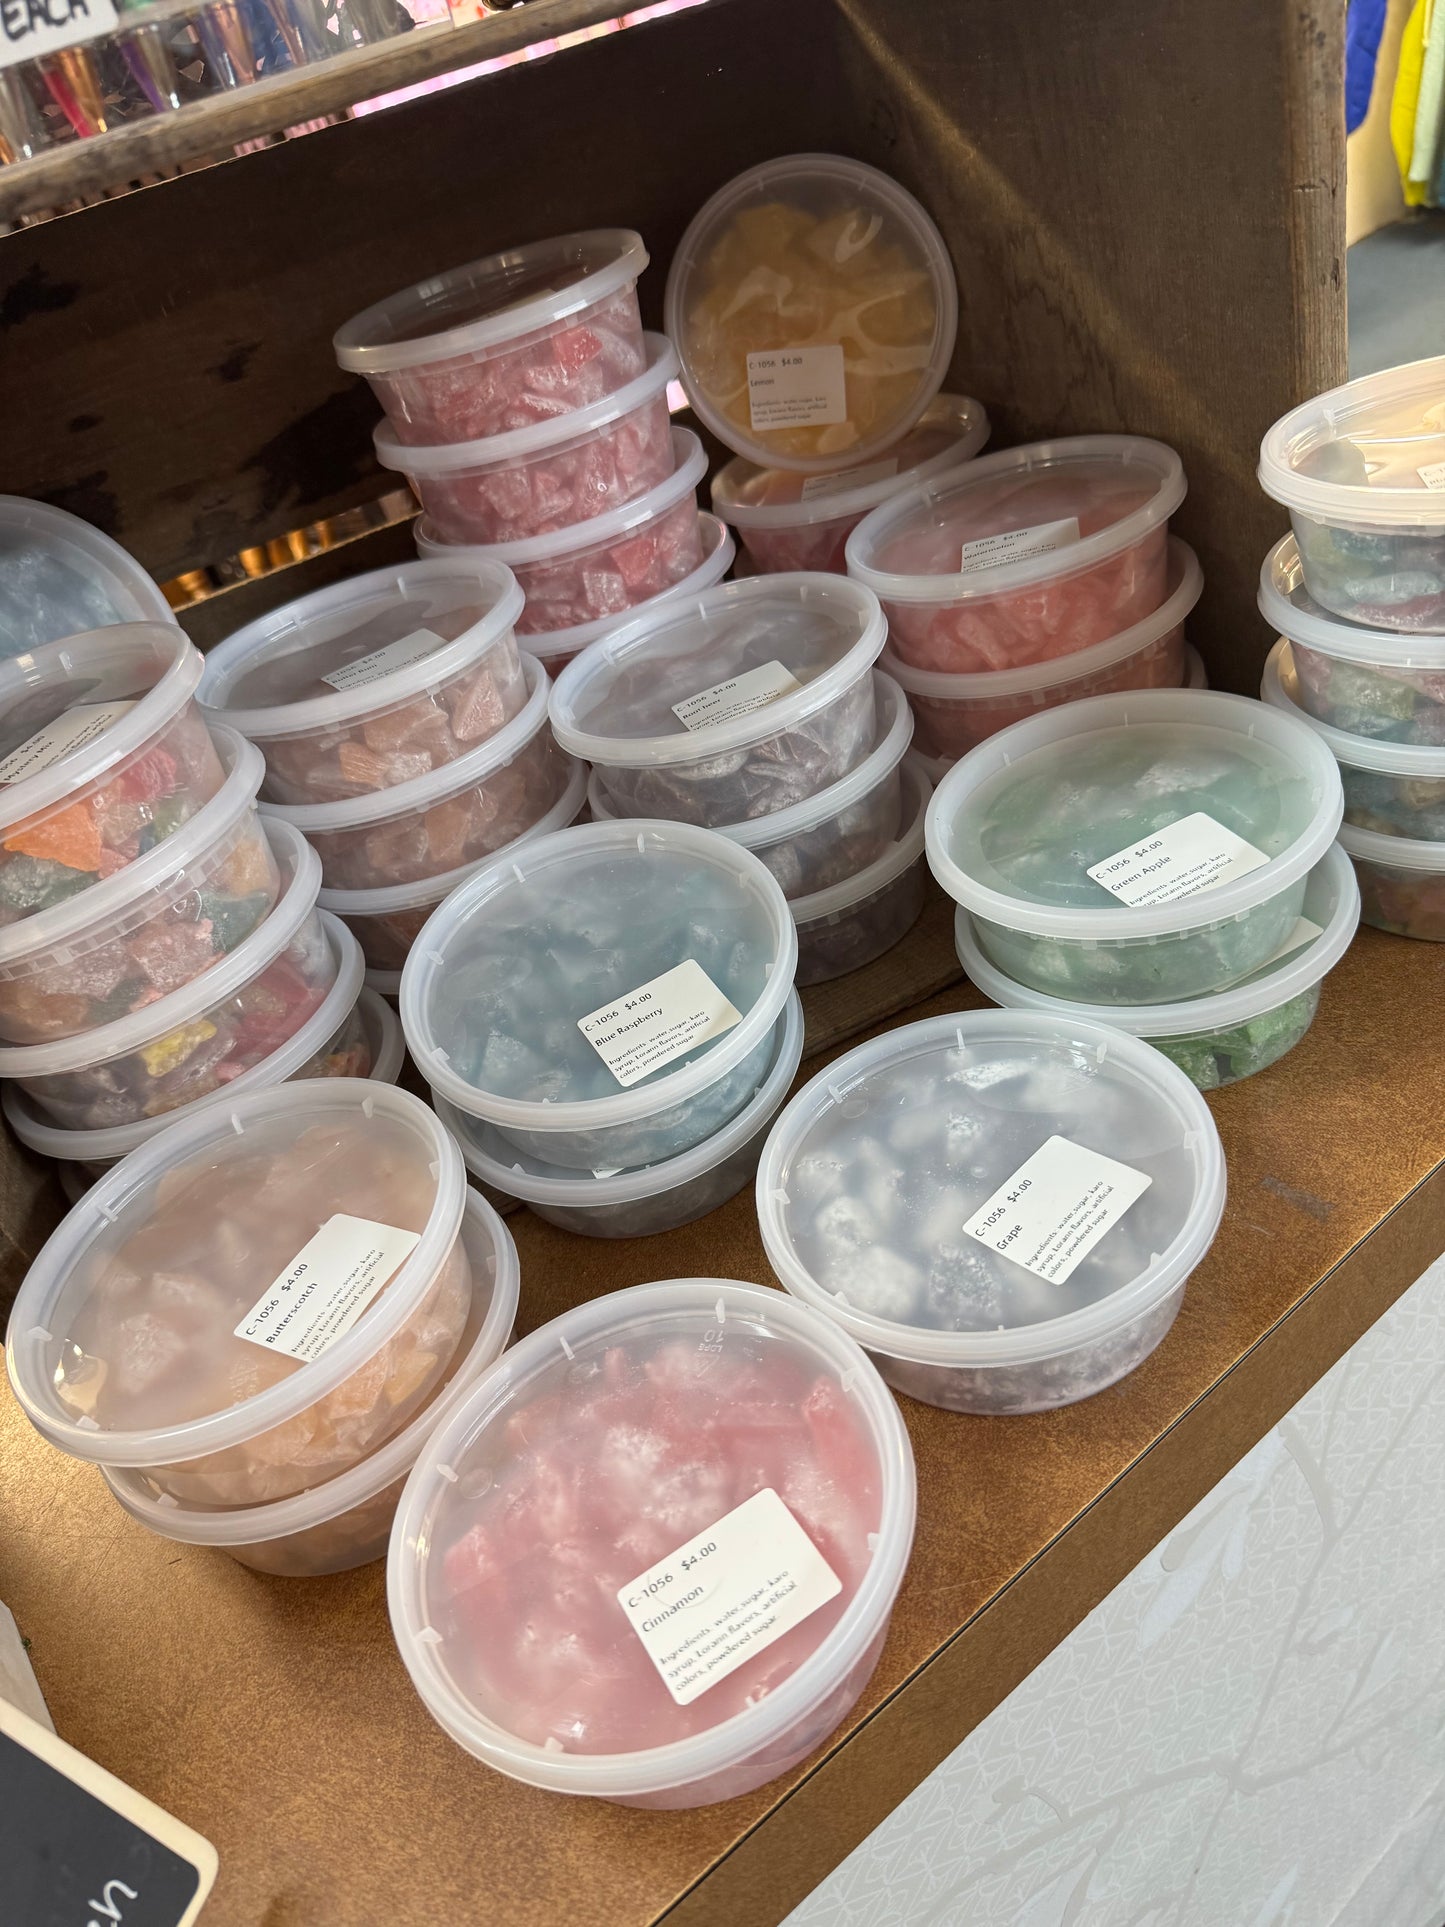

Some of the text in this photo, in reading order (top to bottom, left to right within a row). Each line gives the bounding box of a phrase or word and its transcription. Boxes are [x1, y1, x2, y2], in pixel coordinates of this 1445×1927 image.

[0, 0, 90, 41] EACH
[964, 543, 1015, 560] Watermelon
[1095, 840, 1163, 880] C-1056 $4.00
[1111, 855, 1172, 892] Green Apple
[584, 993, 652, 1032] C-1056 $4.00
[595, 1007, 663, 1047] Blue Raspberry
[642, 1045, 675, 1067] powdered
[975, 1179, 1033, 1238] C-1056 $4.00
[1093, 1185, 1114, 1209] artificial
[996, 1224, 1023, 1251] Grape
[1066, 1225, 1093, 1258] powdered
[246, 1263, 308, 1336] C-1056 $4.00
[266, 1282, 318, 1344] Butterscotch
[628, 1542, 717, 1608] C-1056 $4.00
[641, 1585, 704, 1633] Cinnamon
[763, 1580, 798, 1611] artificial
[706, 1632, 752, 1670] powdered
